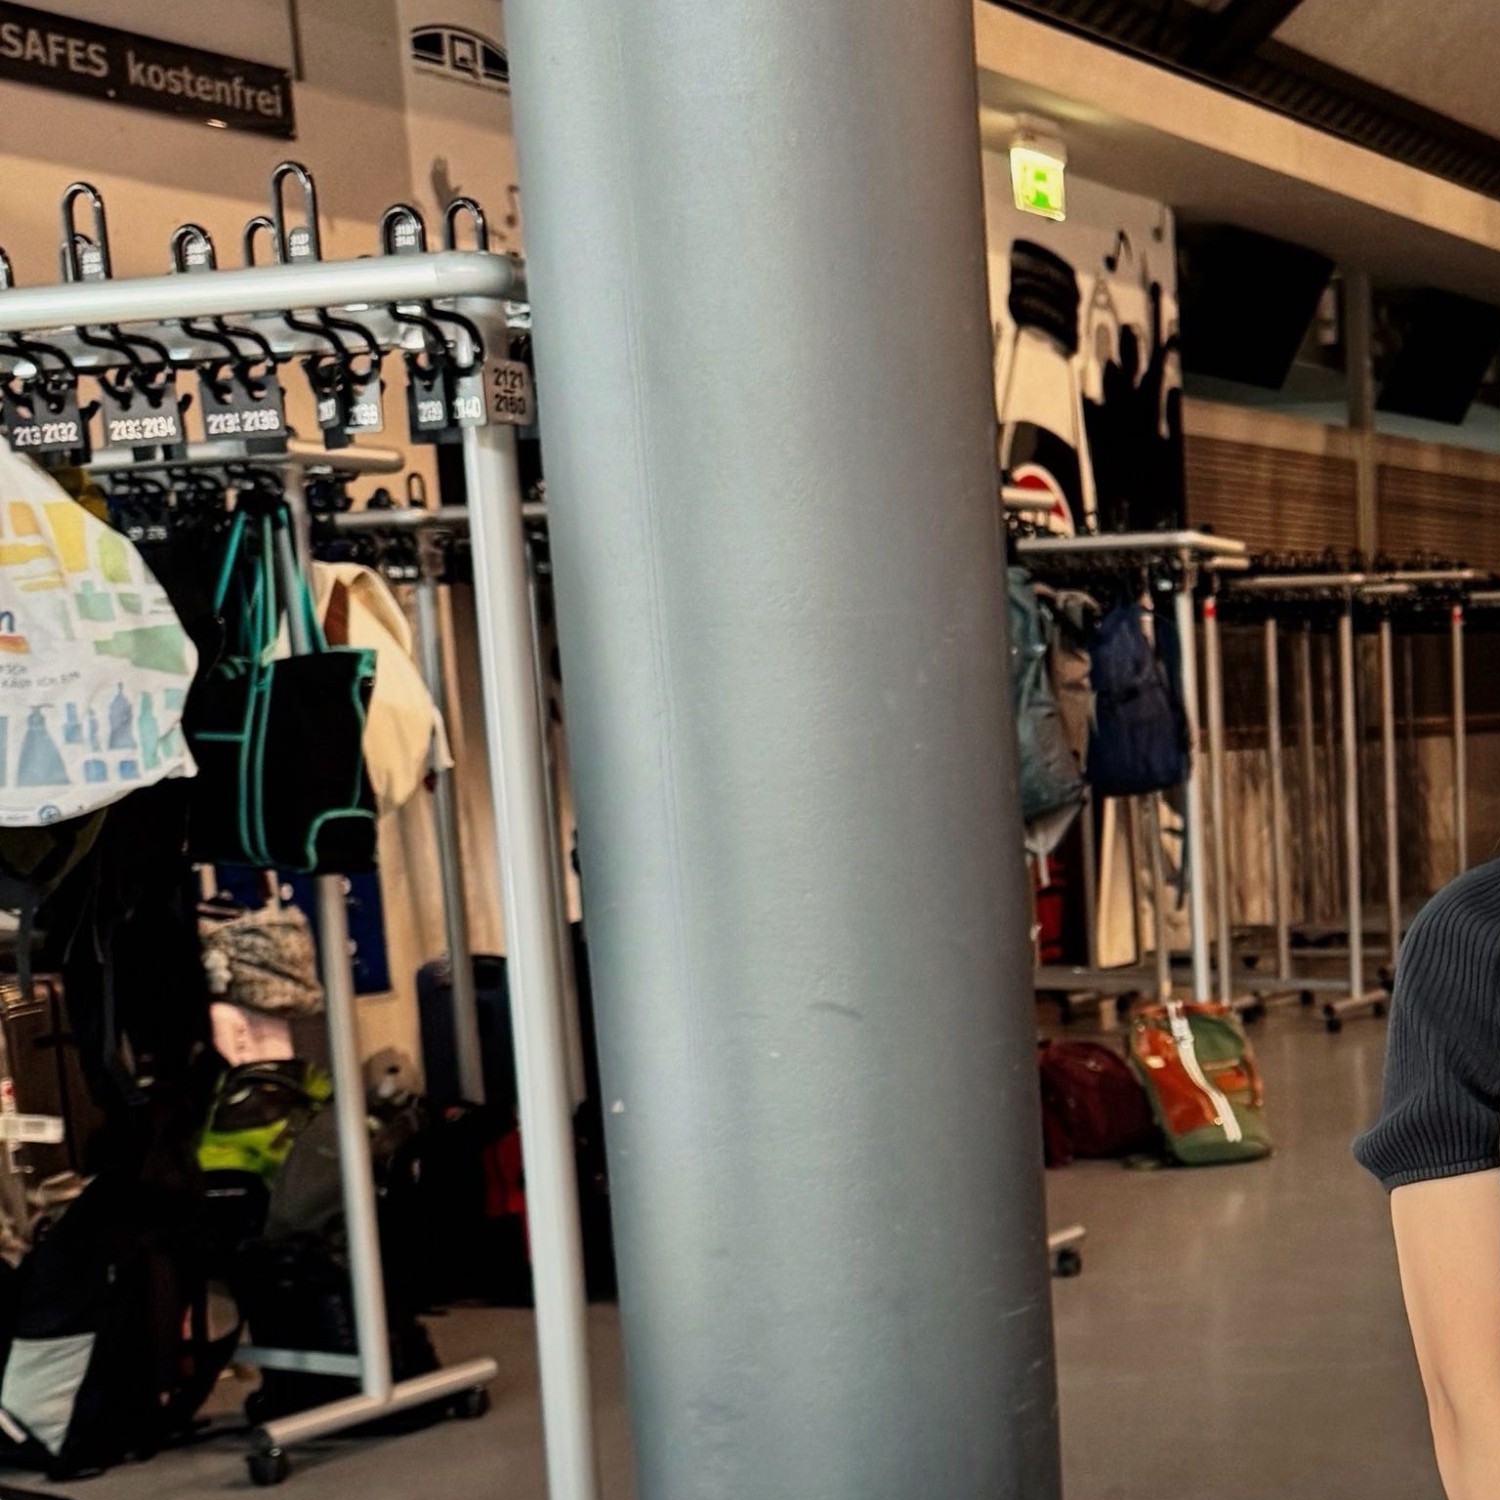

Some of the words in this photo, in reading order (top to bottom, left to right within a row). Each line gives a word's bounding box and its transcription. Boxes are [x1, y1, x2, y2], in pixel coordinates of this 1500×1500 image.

[1, 22, 109, 78] SAFES
[127, 49, 283, 117] kostenfrei
[13, 425, 41, 446] 213
[42, 422, 78, 443] 2132
